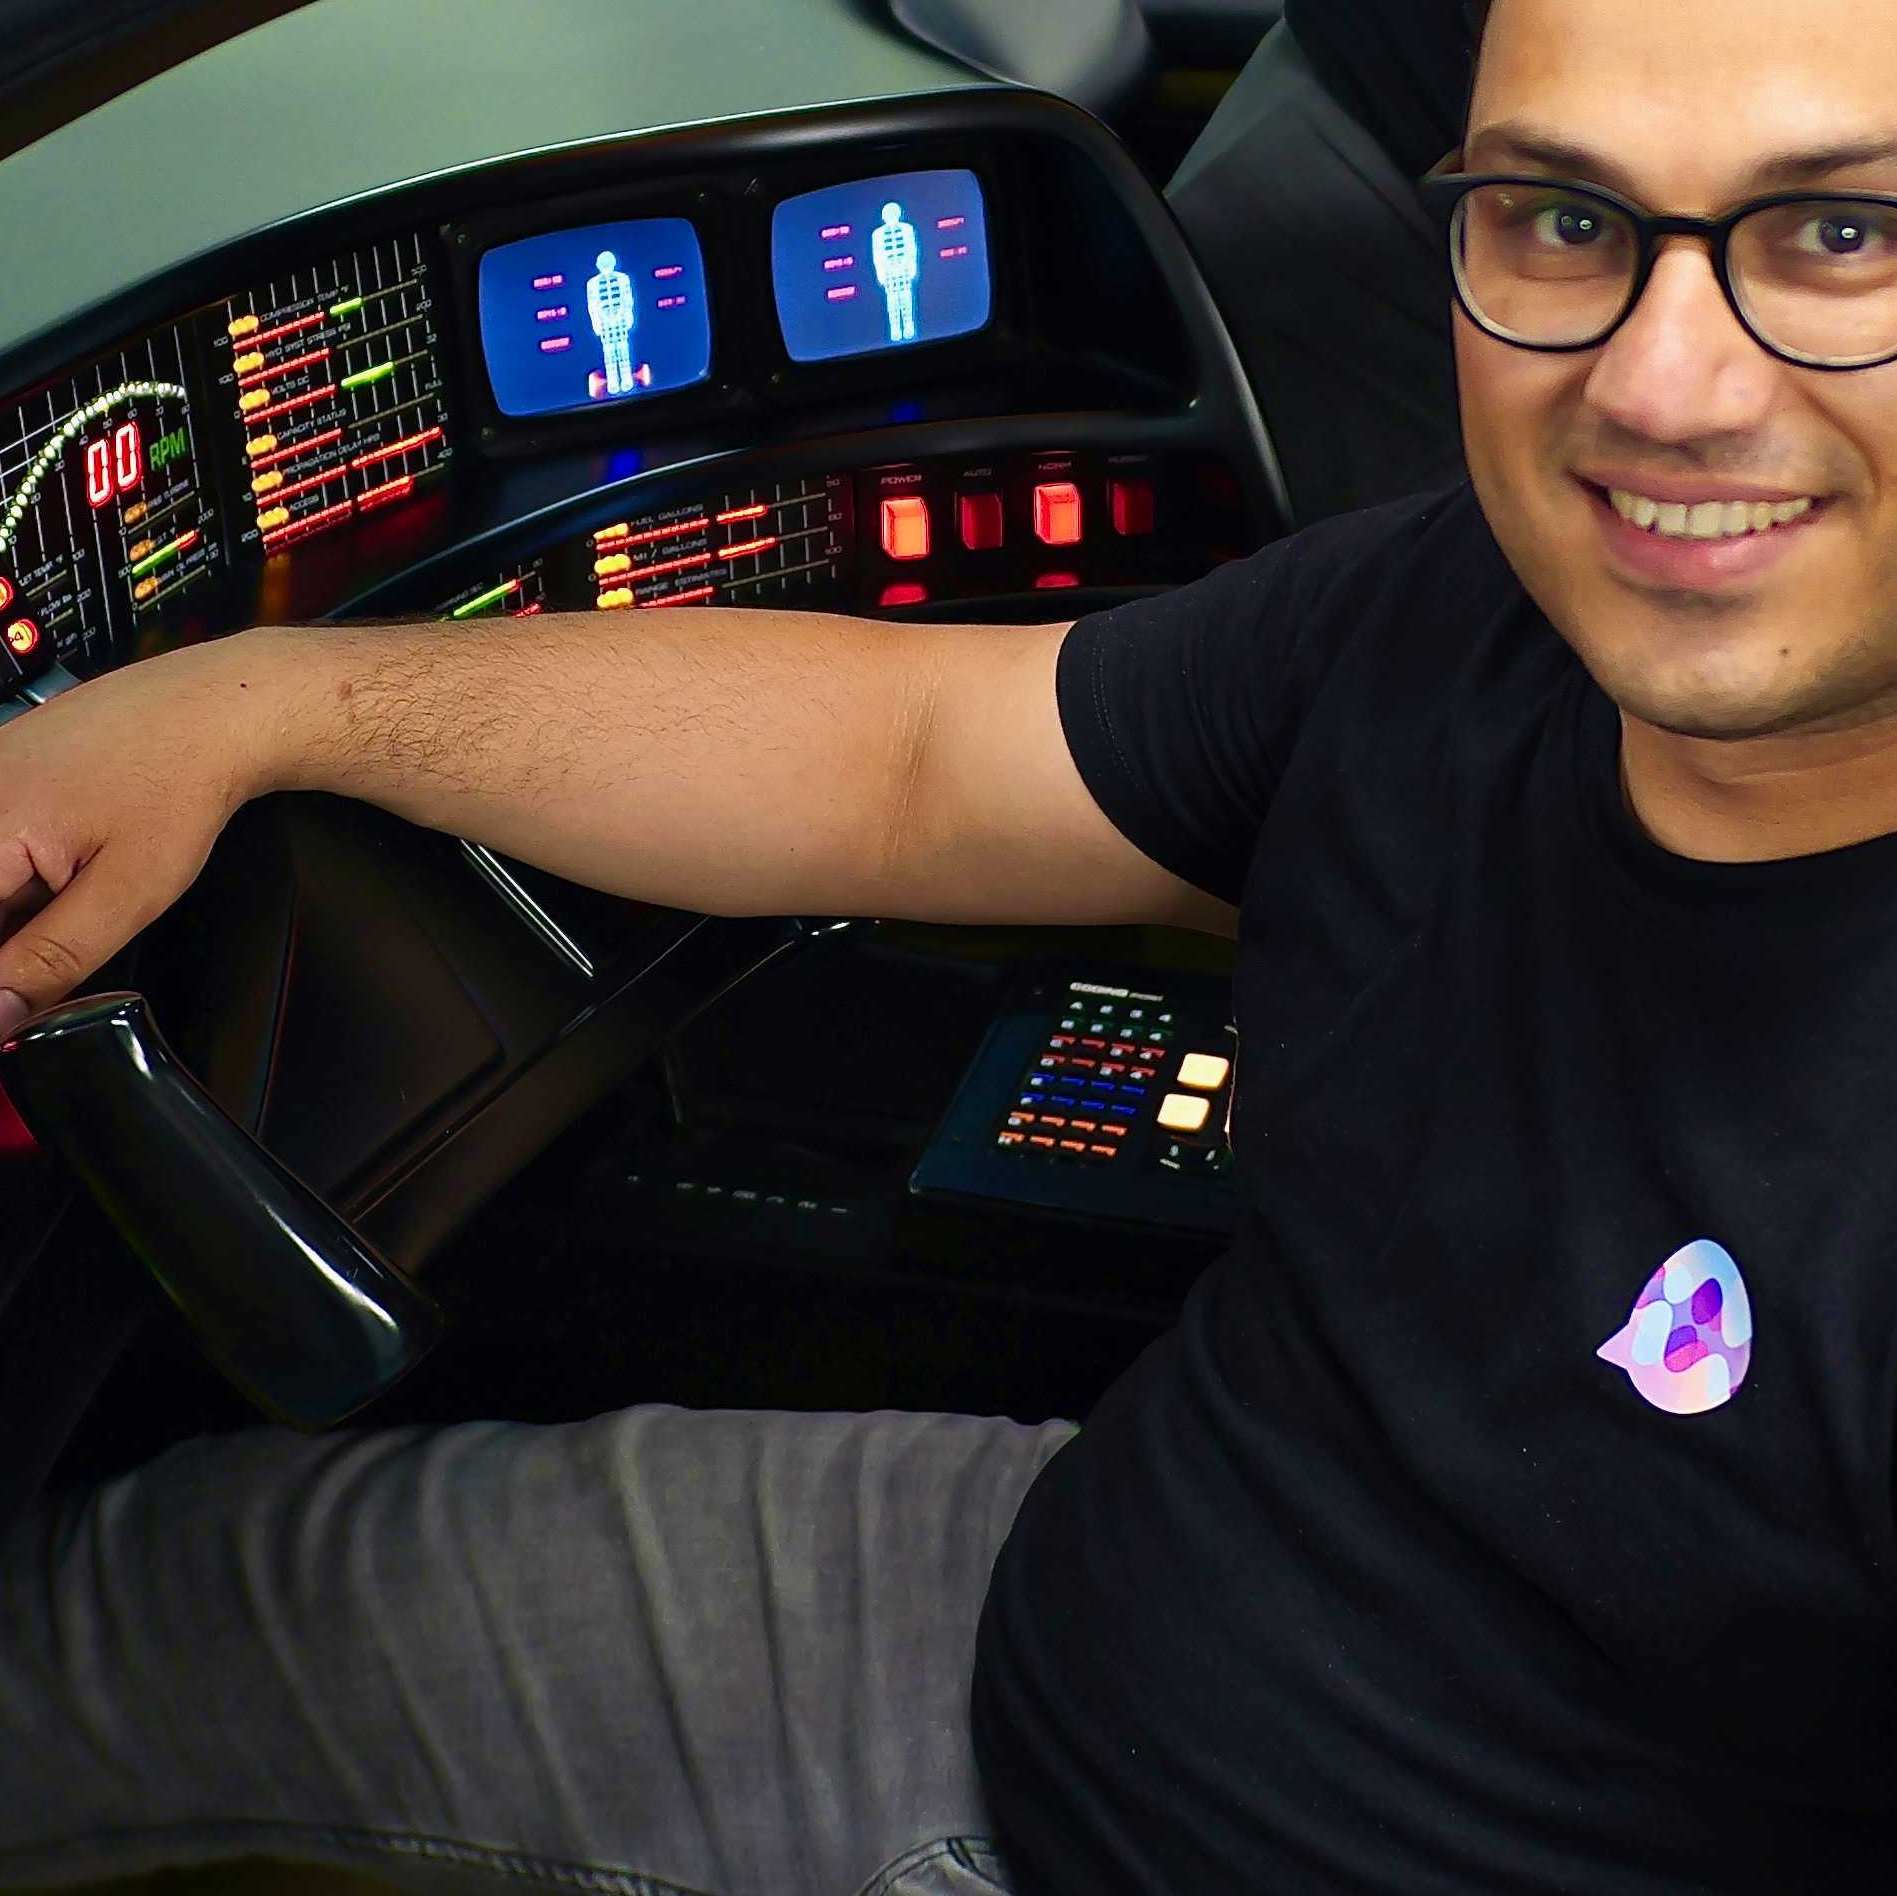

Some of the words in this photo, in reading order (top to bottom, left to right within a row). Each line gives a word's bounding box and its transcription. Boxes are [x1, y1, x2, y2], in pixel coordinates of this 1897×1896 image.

[260, 297, 315, 323] COMPRESSOR
[87, 421, 139, 504] 00
[149, 427, 189, 471] RPM
[880, 474, 923, 486] POWER
